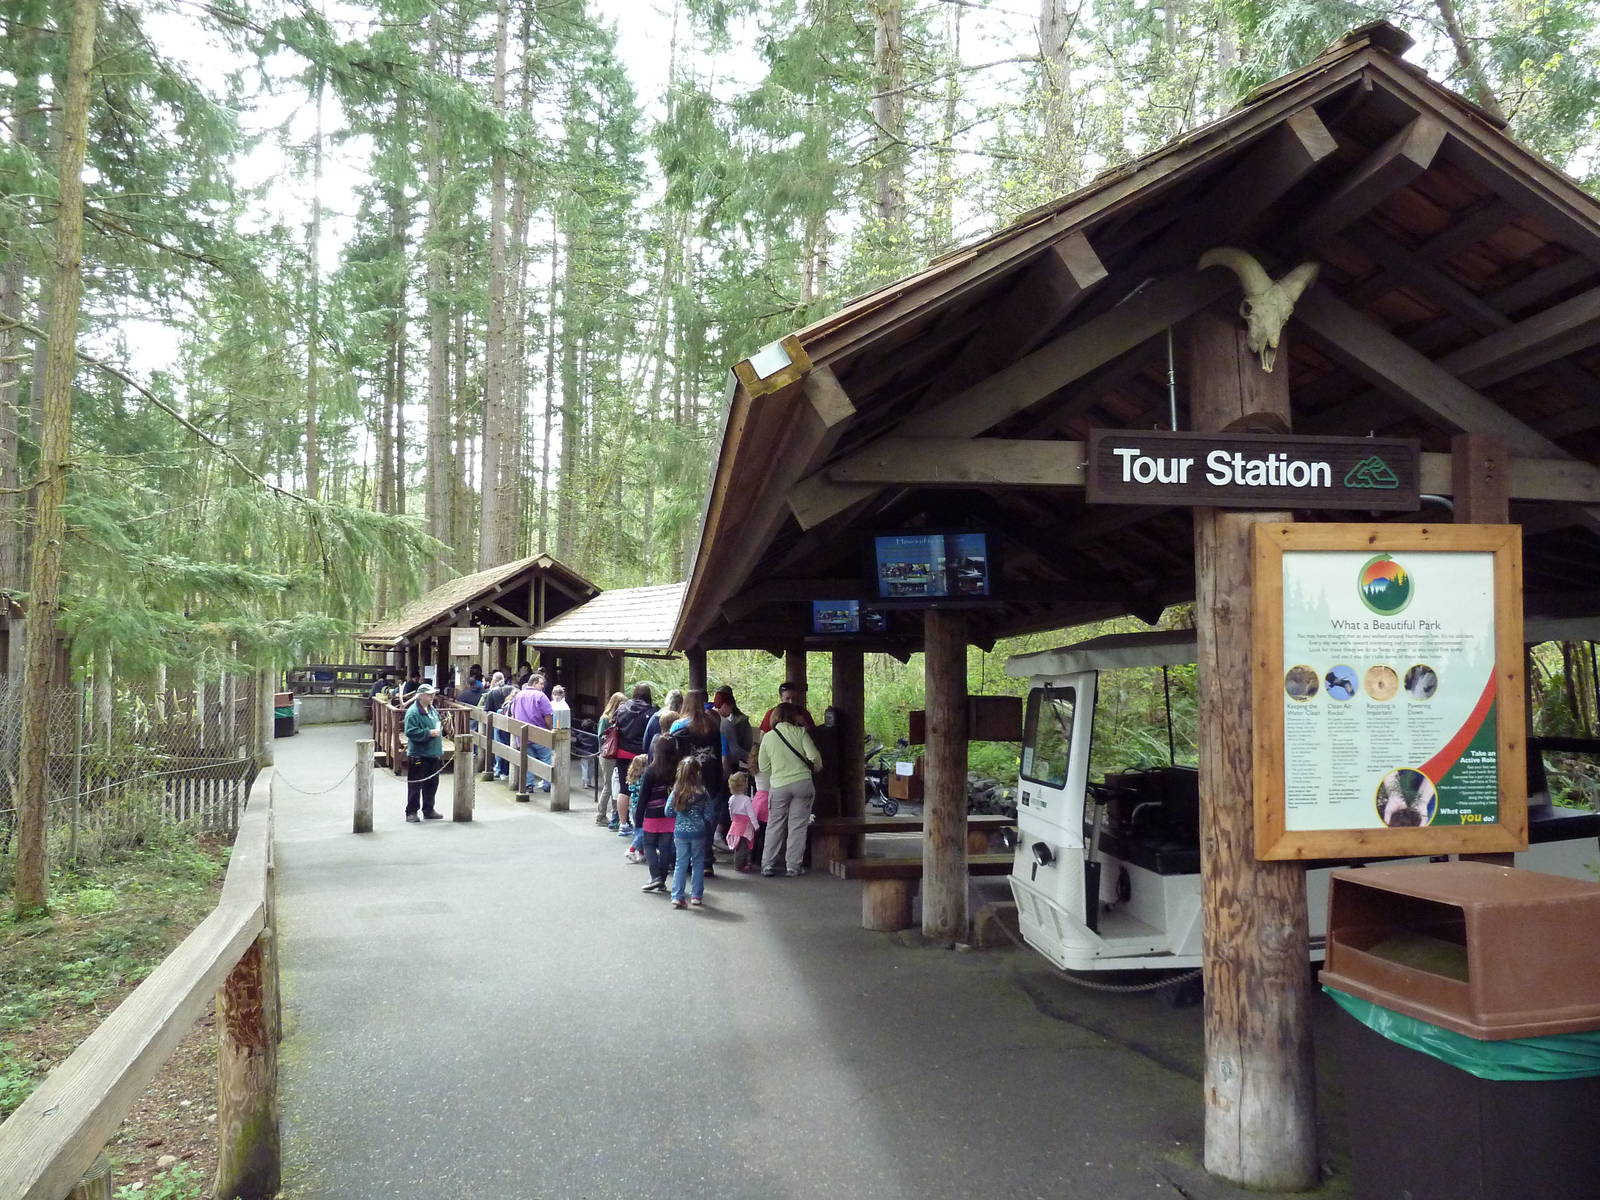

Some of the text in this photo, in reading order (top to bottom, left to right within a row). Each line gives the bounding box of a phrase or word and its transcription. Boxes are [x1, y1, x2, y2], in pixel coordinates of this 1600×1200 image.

[1113, 448, 1332, 488] Tour Station
[1331, 619, 1441, 630] What a Beautiful Park
[1460, 813, 1482, 825] you
